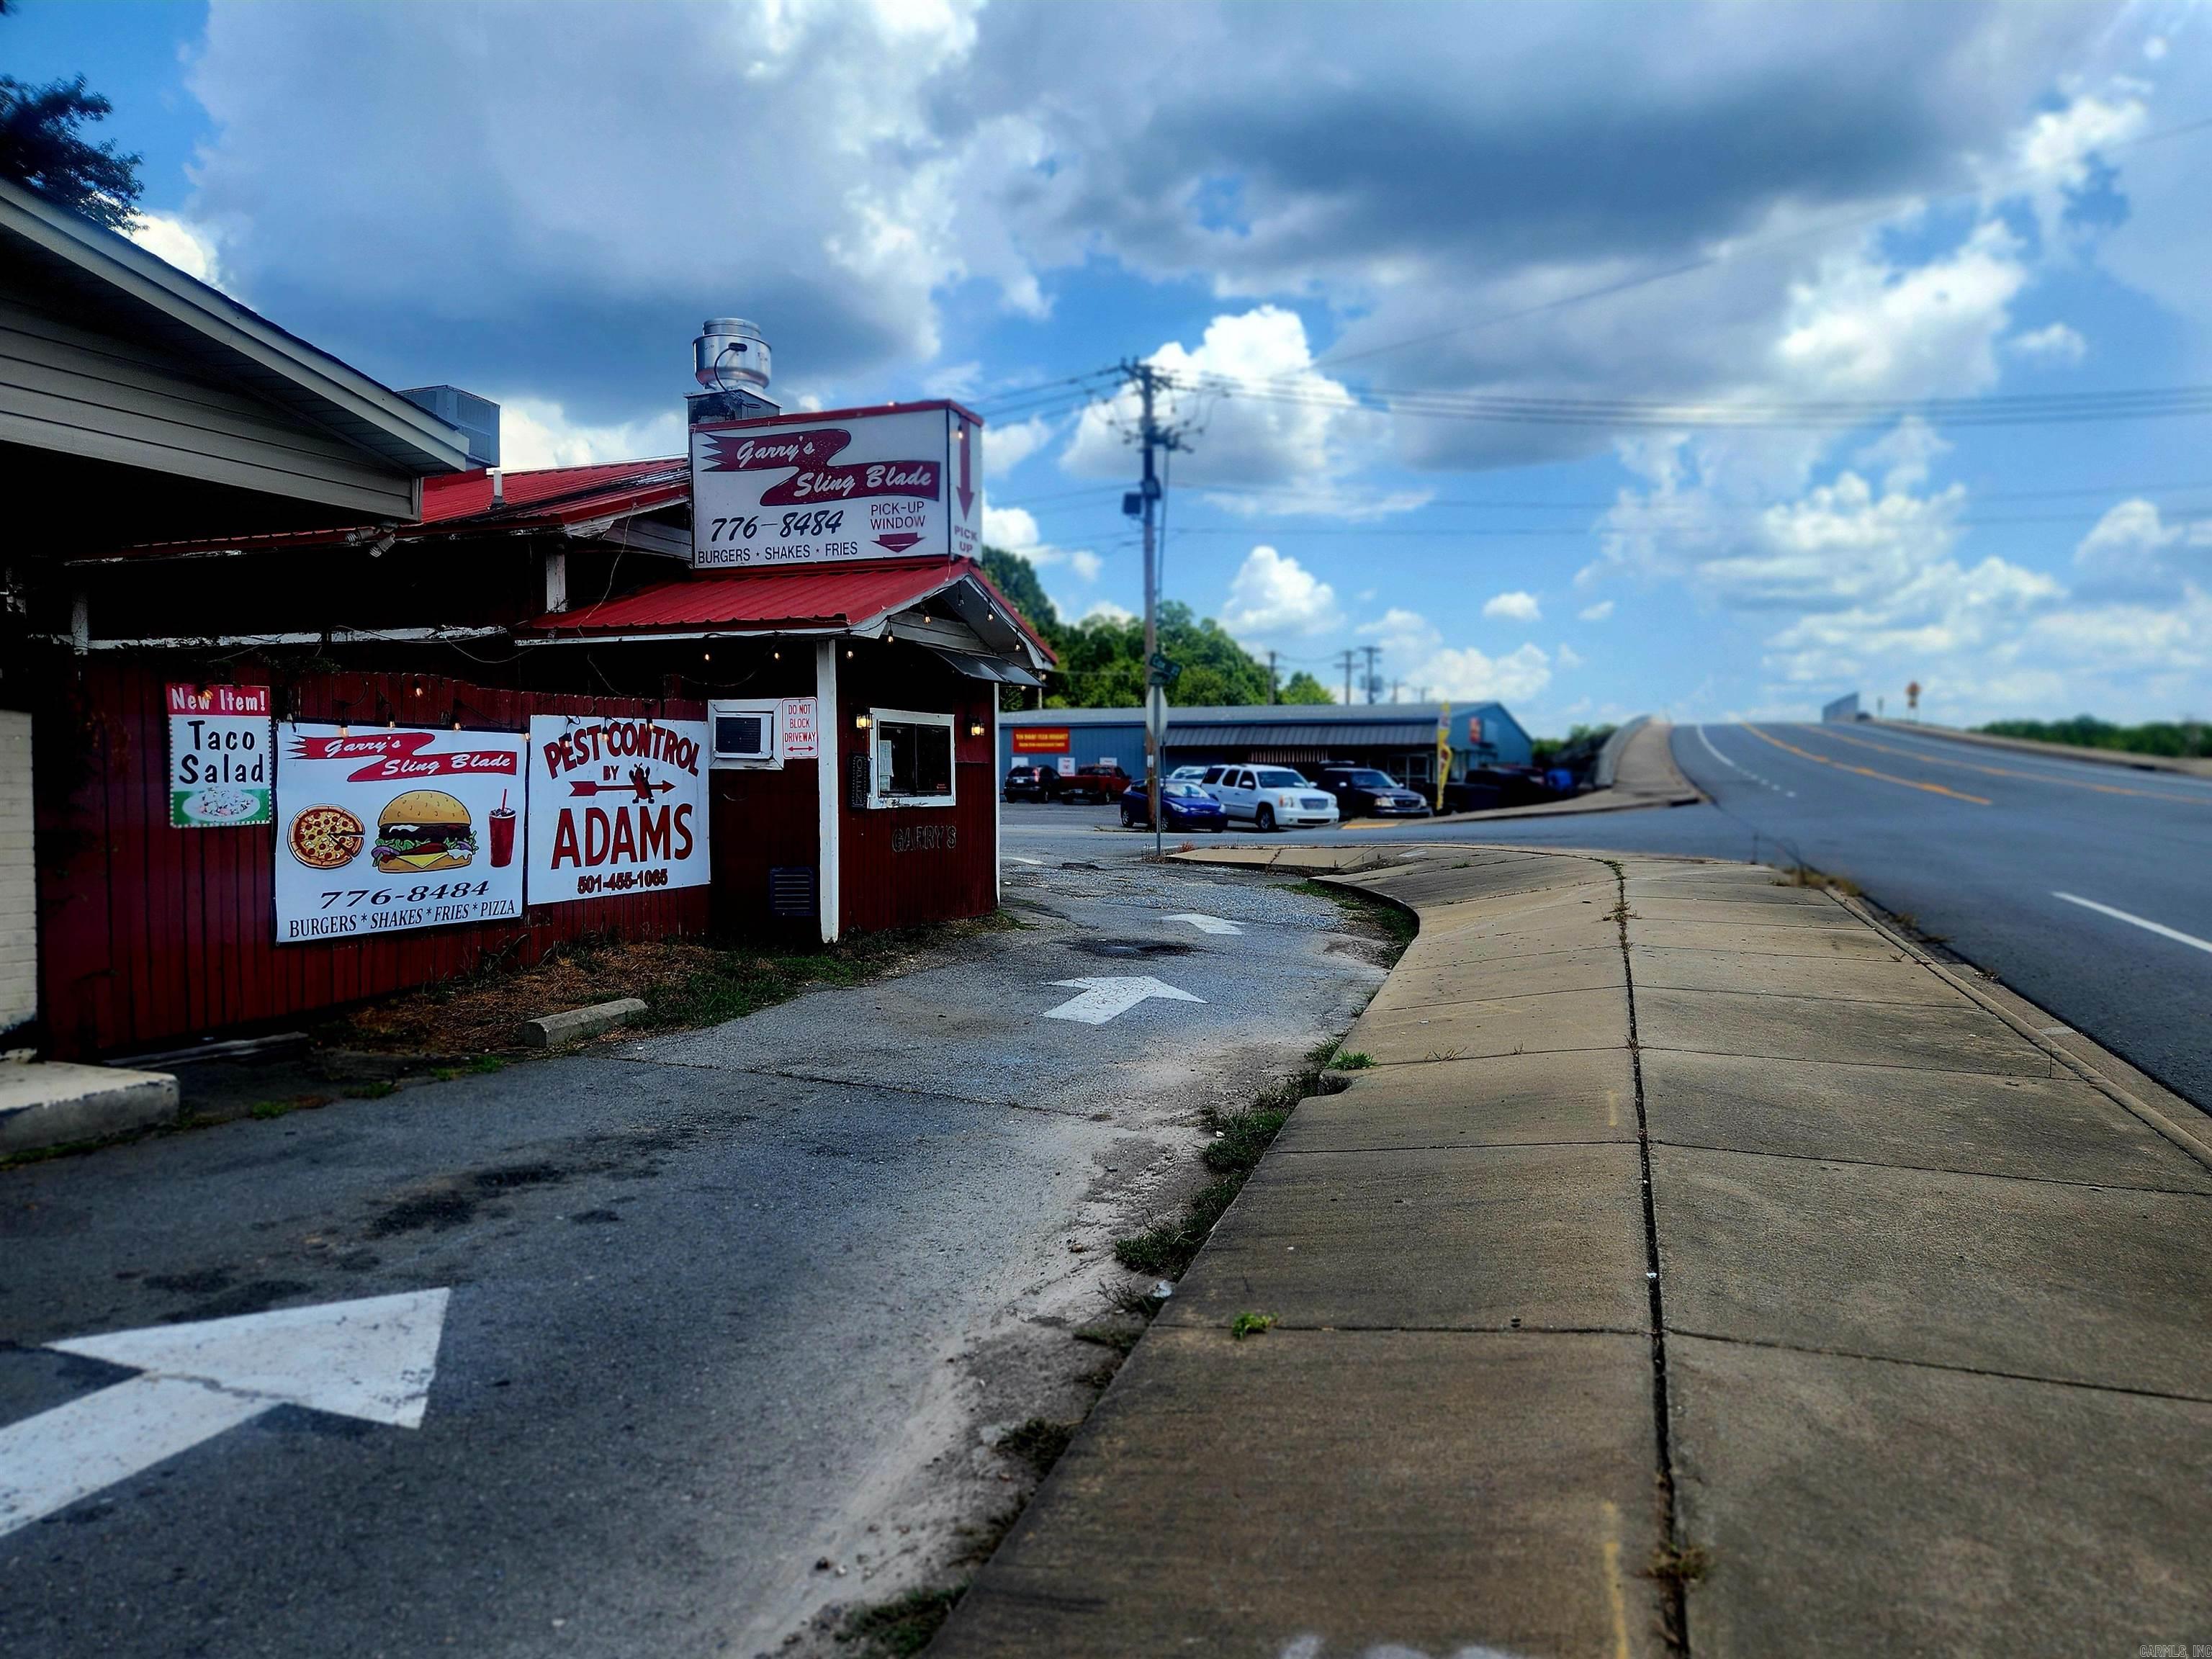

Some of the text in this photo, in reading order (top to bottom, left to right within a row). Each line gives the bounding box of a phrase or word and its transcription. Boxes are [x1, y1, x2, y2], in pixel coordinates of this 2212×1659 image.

[737, 436, 815, 468] Garry's
[793, 465, 932, 497] Sling Blade
[871, 501, 925, 516] PICK-UP
[711, 510, 845, 542] 776-8484
[871, 516, 926, 530] WINDOW
[954, 525, 978, 541] PICK
[698, 541, 858, 564] BURGERS SHAKES FRIES
[959, 541, 973, 552] UP
[171, 687, 266, 711] New Item!
[788, 704, 811, 714] DO NOT
[790, 718, 810, 728] BLOCK
[187, 720, 255, 751] Taco
[324, 736, 401, 757] Garry's
[784, 732, 816, 742] DRIVEWAY
[543, 721, 700, 780] PEST CONTROL
[179, 753, 264, 784] Salad
[382, 754, 511, 776] Sling Blade
[603, 765, 619, 781] BY
[551, 803, 693, 870] ADAMS
[577, 868, 668, 894] 501-455-1065
[320, 881, 490, 909] 776-8484
[289, 899, 515, 938] BURGERS SHAKES FRIES PIZZA
